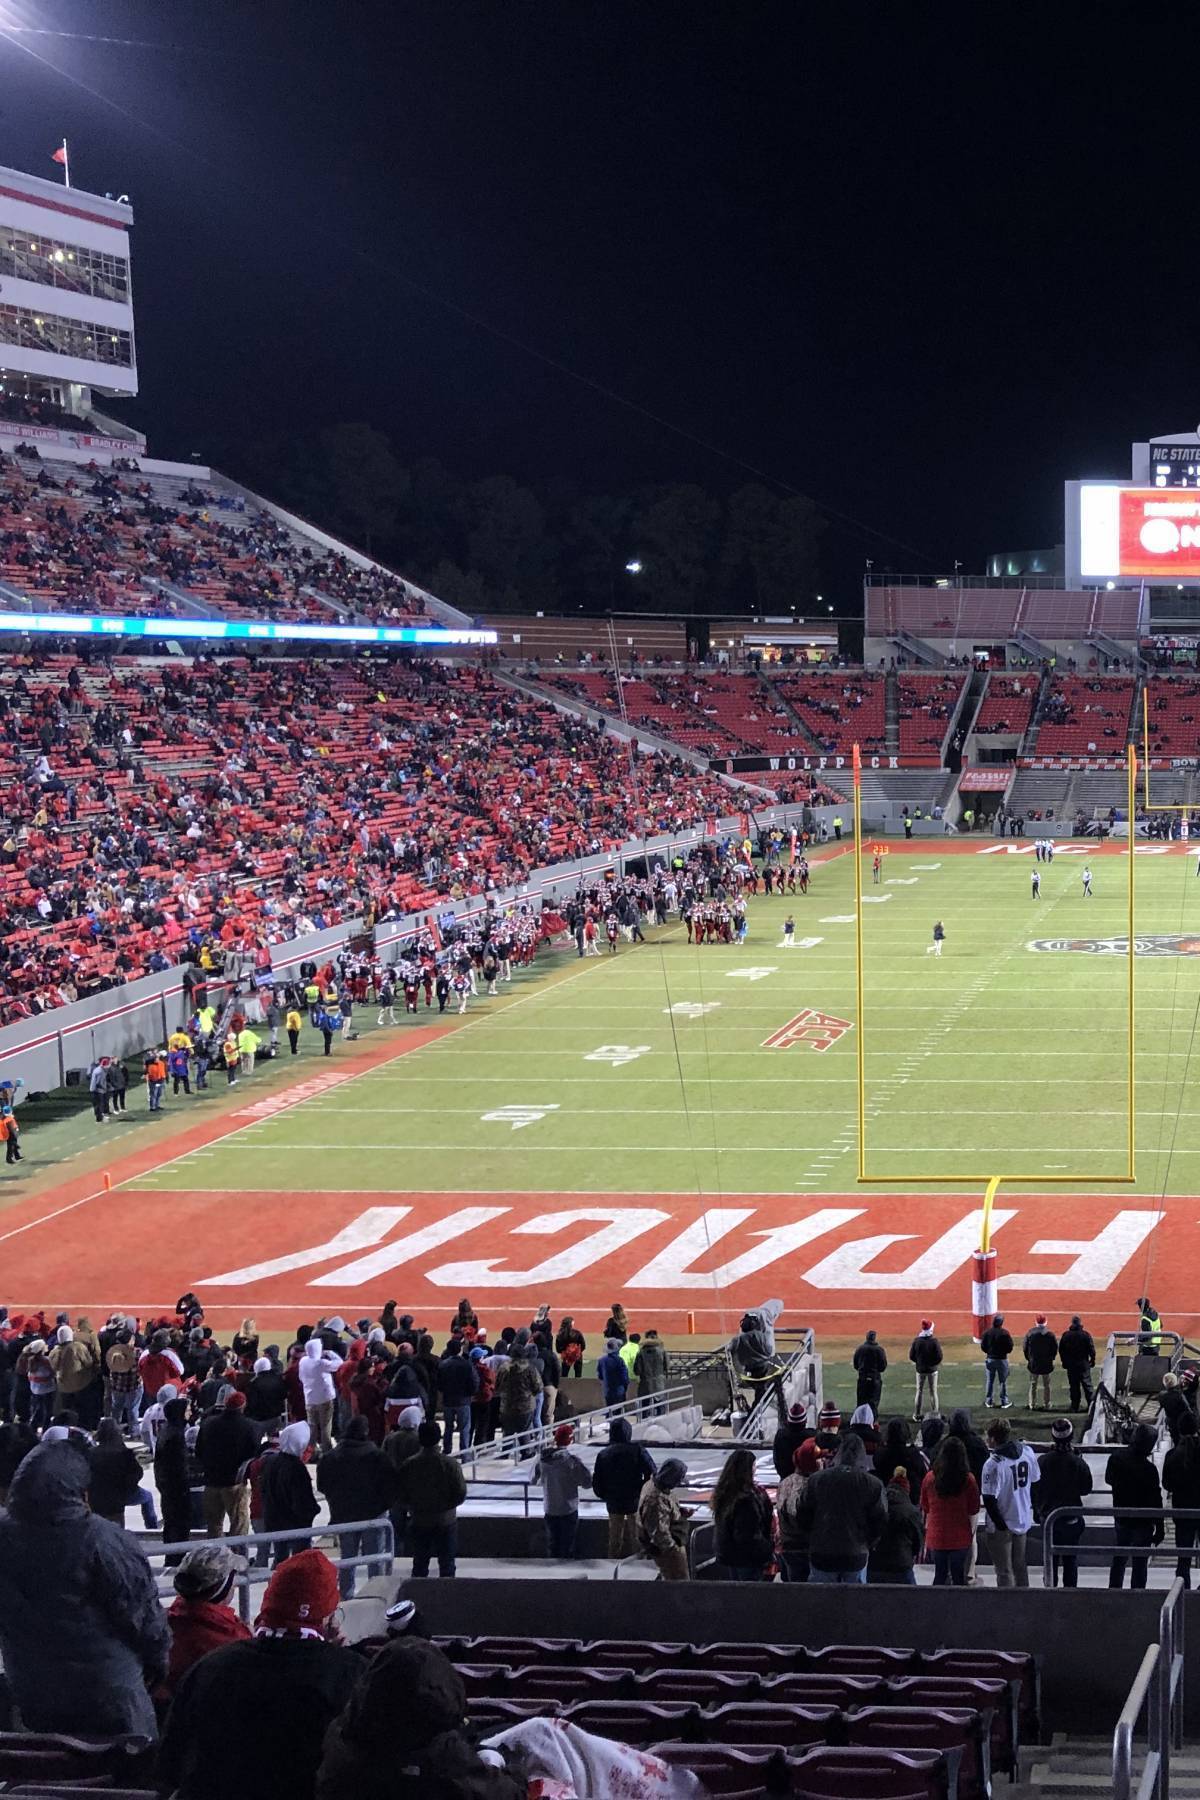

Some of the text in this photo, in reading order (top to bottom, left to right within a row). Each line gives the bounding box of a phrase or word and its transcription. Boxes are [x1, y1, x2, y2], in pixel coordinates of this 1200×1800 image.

[1153, 448, 1168, 460] NC
[975, 844, 1103, 855] NC
[762, 1008, 855, 1053] ACC
[1009, 1461, 1029, 1491] 19
[298, 1604, 310, 1617] S
